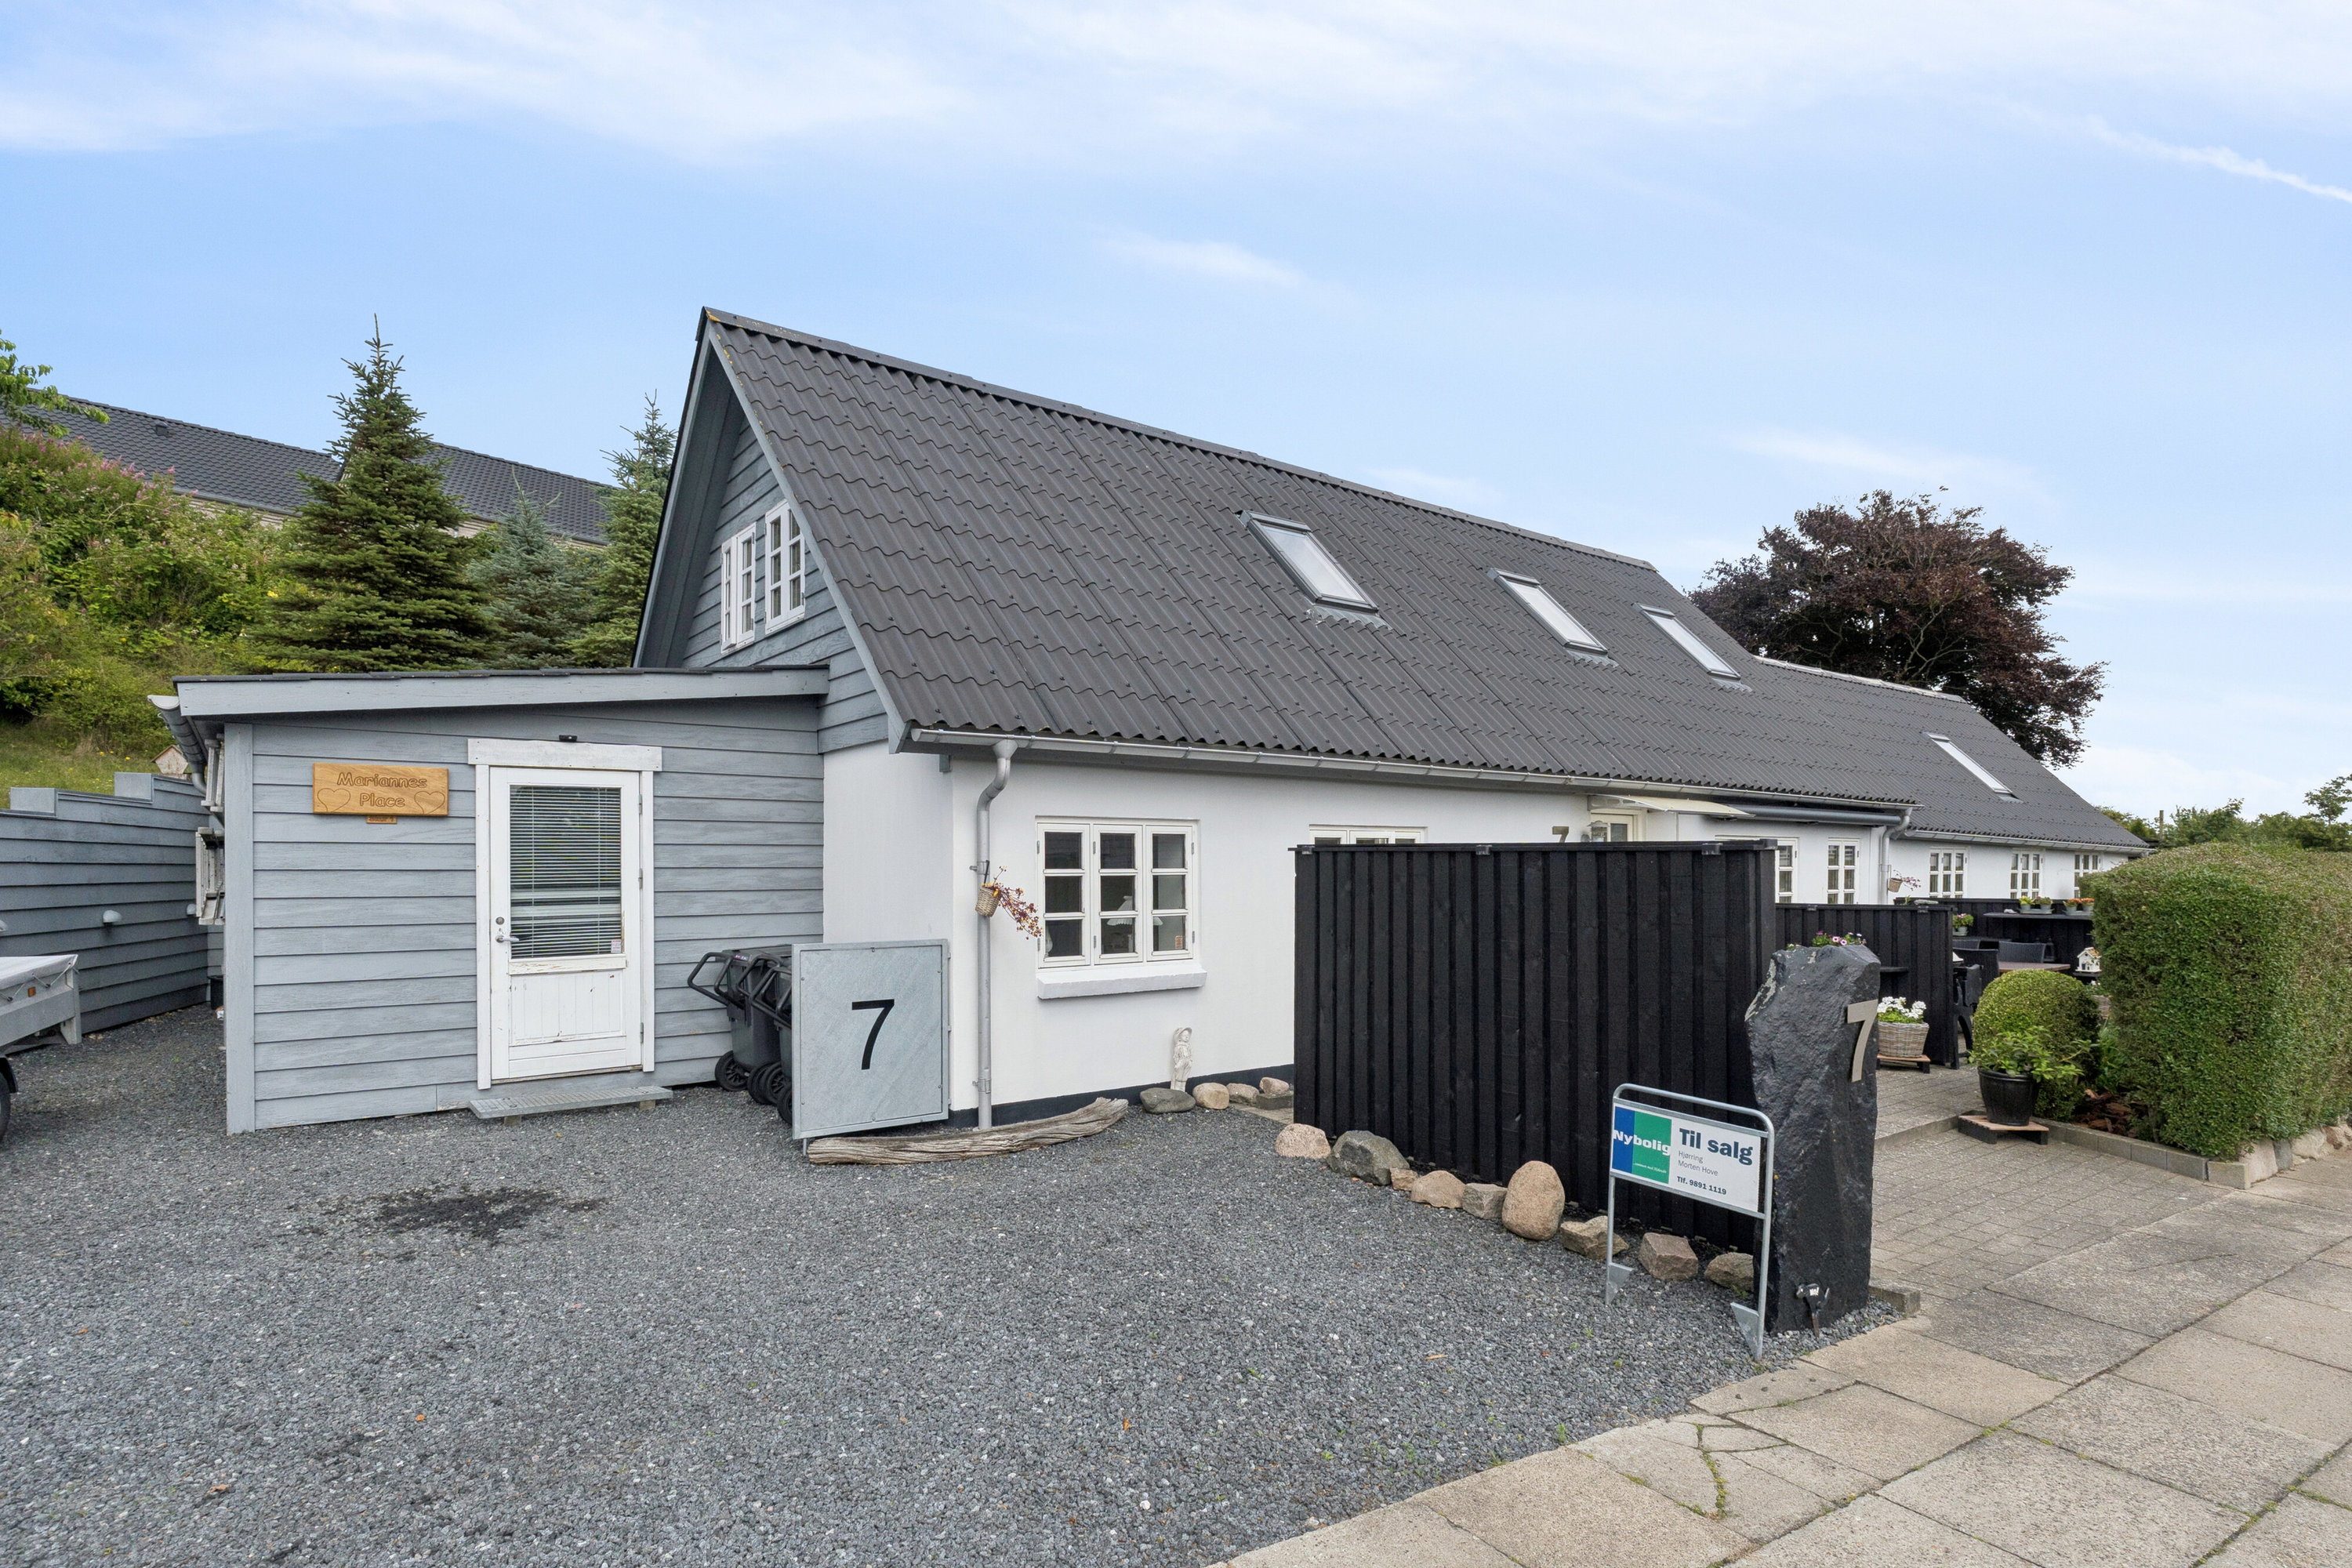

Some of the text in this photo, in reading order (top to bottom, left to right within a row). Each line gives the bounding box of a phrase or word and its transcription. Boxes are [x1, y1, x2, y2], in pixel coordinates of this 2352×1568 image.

[336, 772, 427, 788] Mariannes
[359, 793, 405, 807] Place
[851, 999, 895, 1070] 7
[1847, 999, 1878, 1083] 7
[1613, 1130, 1671, 1156] Nybolig
[1679, 1127, 1753, 1166] Til salg
[1678, 1150, 1704, 1163] Hjørring
[1678, 1160, 1700, 1171] Morten
[1701, 1166, 1718, 1176] Hove
[1676, 1176, 1726, 1195] Tlf. 9891 1119
